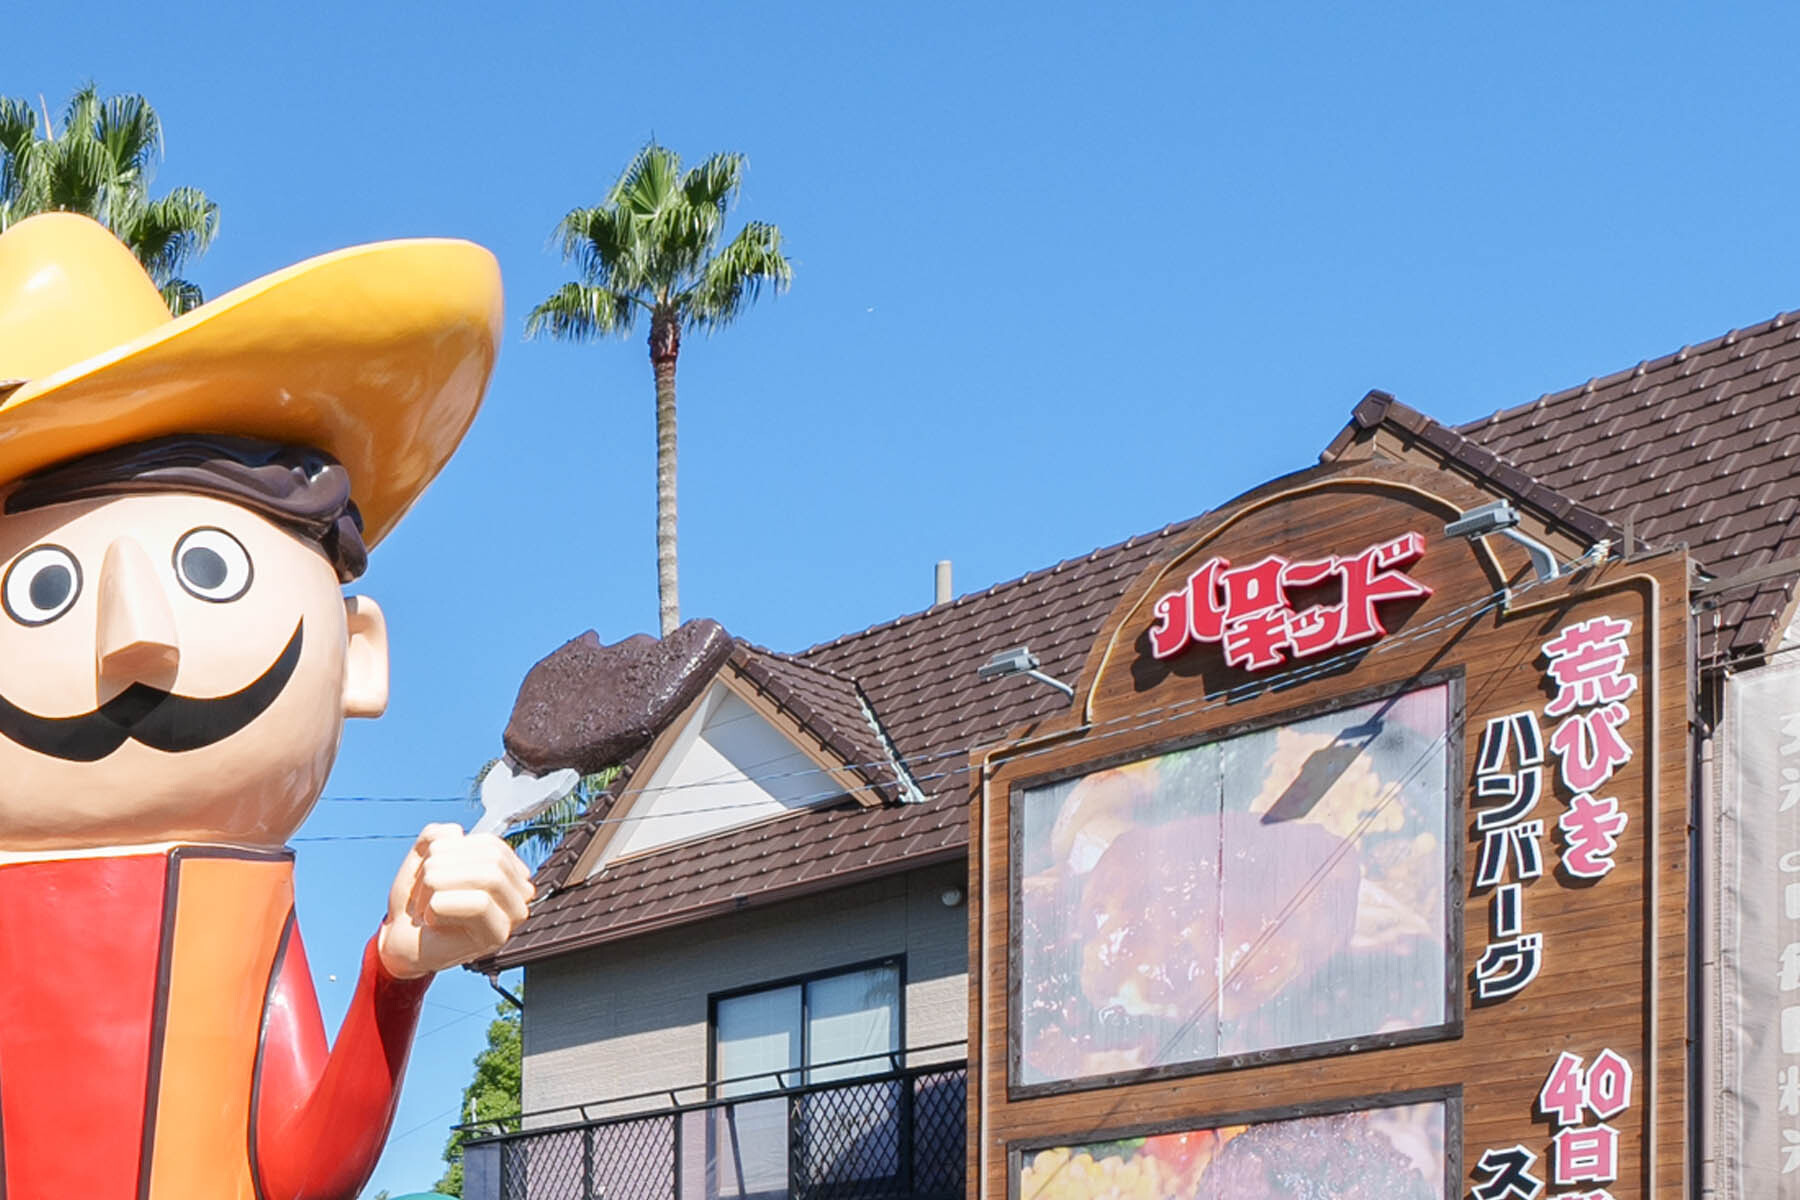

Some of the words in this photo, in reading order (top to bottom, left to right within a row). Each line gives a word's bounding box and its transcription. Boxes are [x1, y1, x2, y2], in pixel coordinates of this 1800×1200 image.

[1476, 710, 1544, 999] ハンバーグ
[1542, 616, 1637, 878] 荒びき
